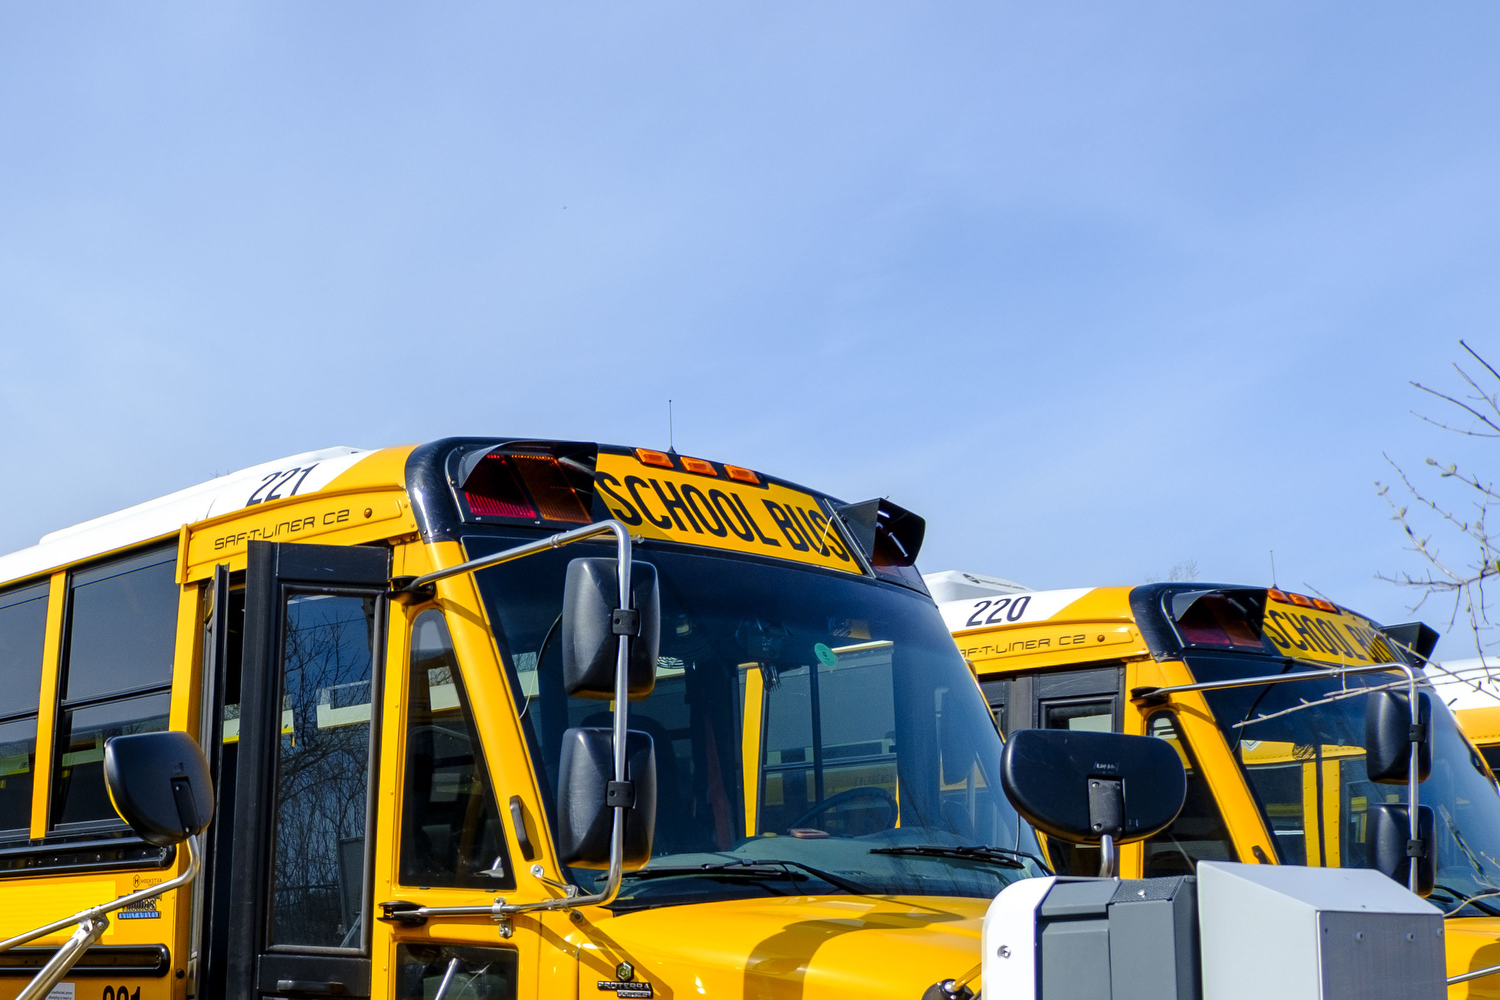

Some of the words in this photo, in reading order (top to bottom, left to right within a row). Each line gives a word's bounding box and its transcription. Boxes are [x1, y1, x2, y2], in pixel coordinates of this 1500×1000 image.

[245, 463, 320, 508] 221
[323, 509, 350, 525] C2
[594, 470, 782, 547] SCHOOL
[761, 498, 851, 563] BUS
[965, 596, 1032, 627] 220
[1058, 634, 1086, 646] C2
[598, 981, 651, 990] PROTERRA
